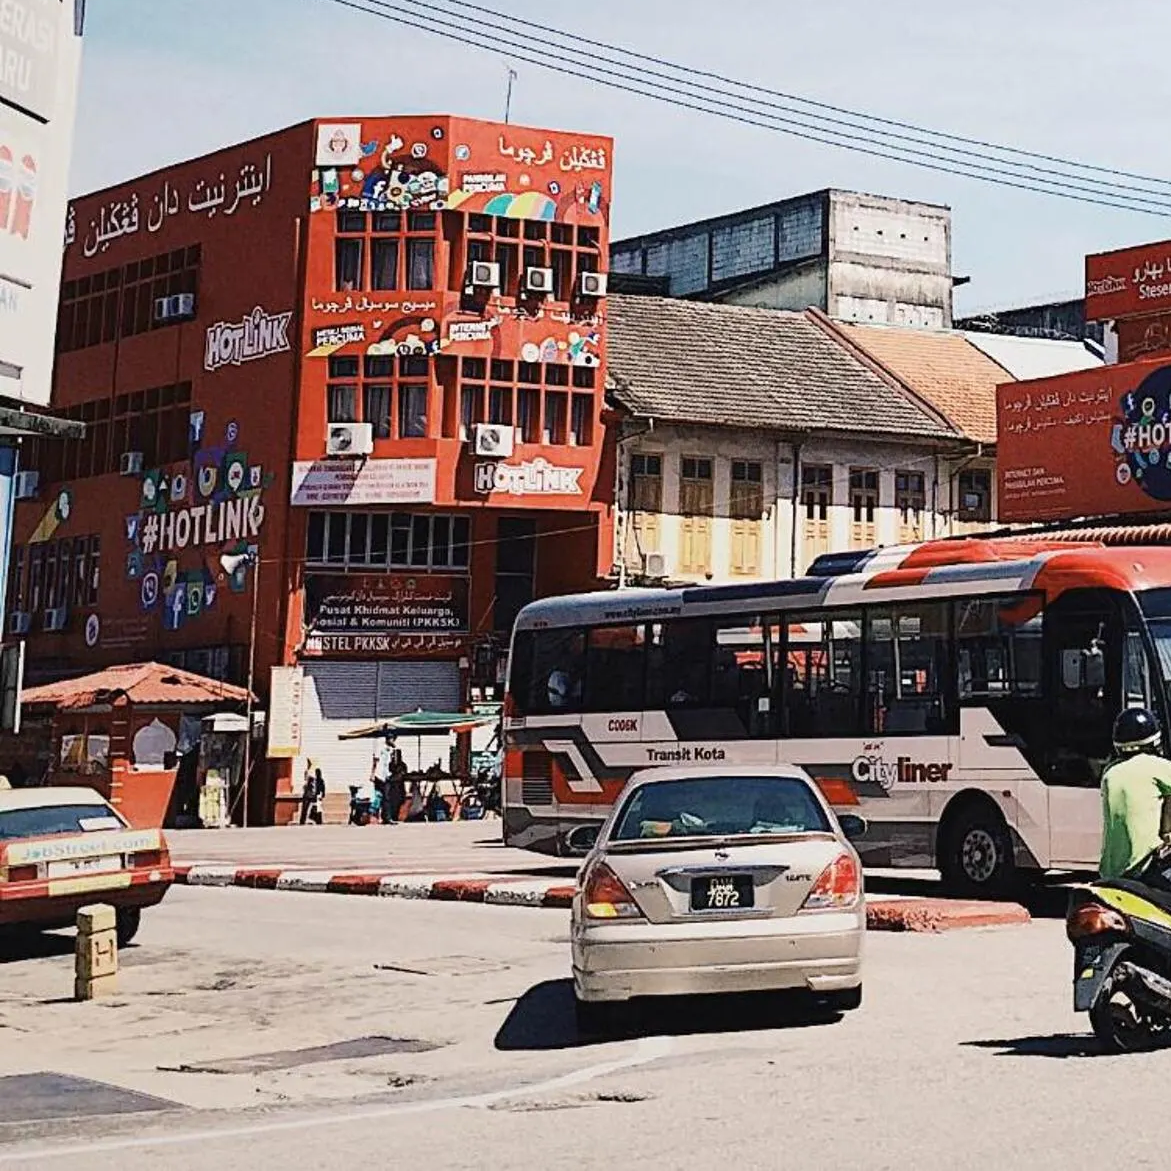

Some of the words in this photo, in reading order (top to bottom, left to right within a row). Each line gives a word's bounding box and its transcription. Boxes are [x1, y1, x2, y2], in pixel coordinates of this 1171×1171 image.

[142, 495, 265, 554] #HOTLINK
[319, 605, 351, 615] Pusat
[354, 605, 399, 614] Khidmat
[314, 617, 346, 626] osial
[350, 617, 358, 626] &
[362, 617, 410, 626] Komuniti
[354, 636, 390, 650] PKKSK
[646, 747, 691, 760] Transit
[694, 747, 725, 760] Kota
[852, 755, 953, 789] Cityliner
[707, 891, 739, 906] 7872
